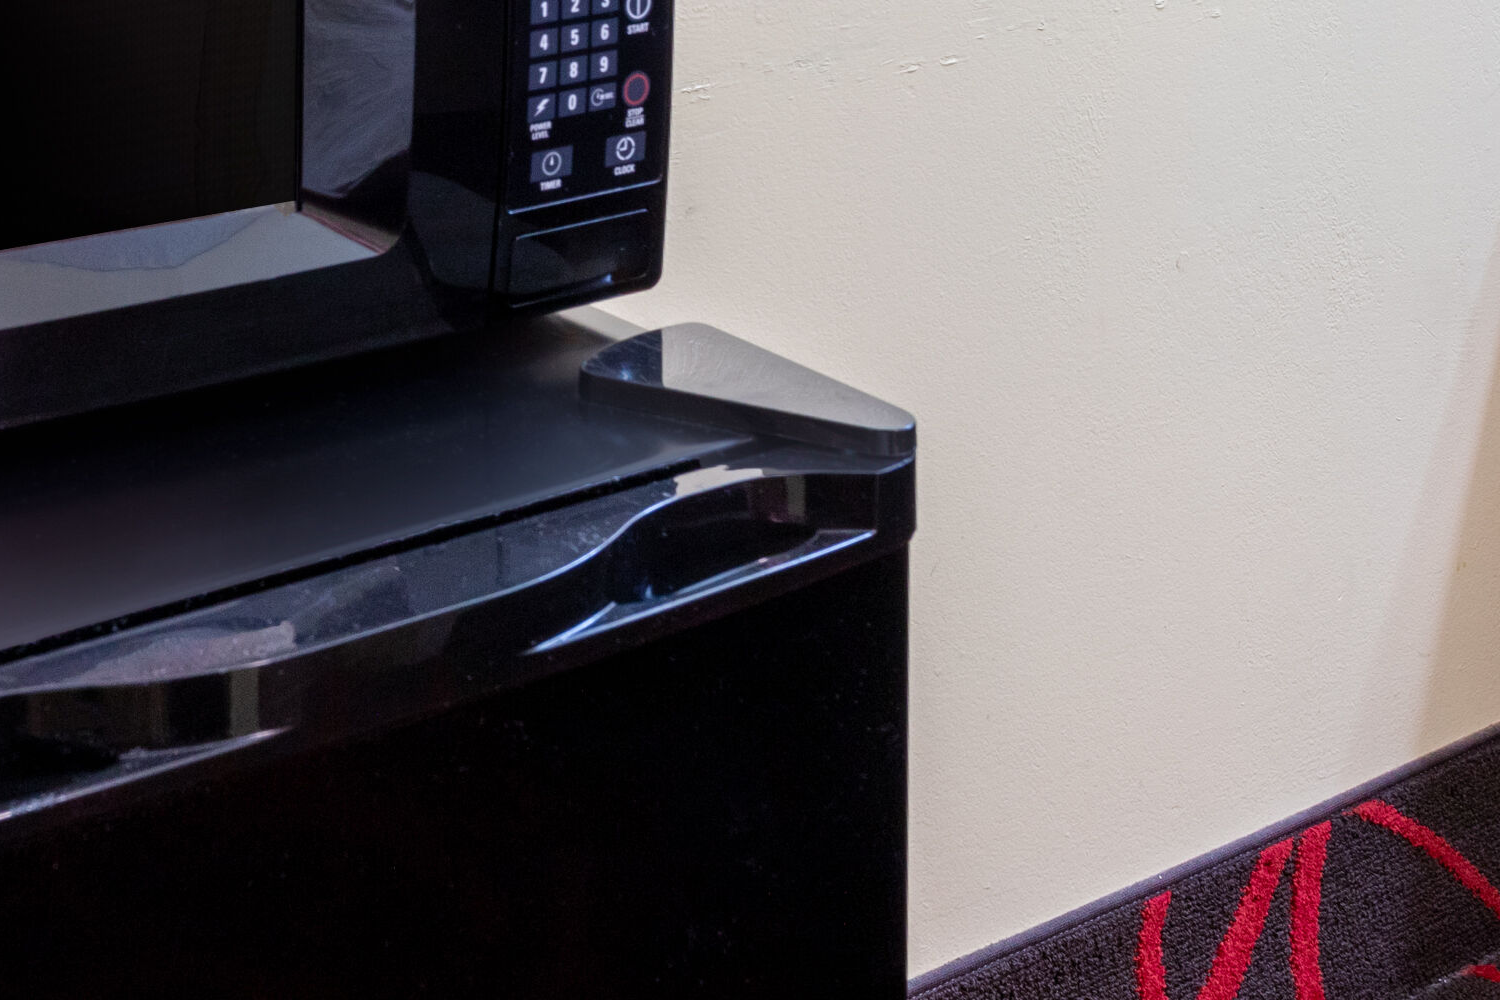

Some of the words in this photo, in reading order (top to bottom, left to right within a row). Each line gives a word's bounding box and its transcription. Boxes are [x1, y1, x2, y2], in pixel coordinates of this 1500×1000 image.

[541, 1, 548, 18] 1
[600, 24, 609, 40] 6
[627, 22, 649, 35] START
[539, 34, 548, 50] 4
[570, 29, 579, 45] 5
[569, 62, 578, 78] 8
[599, 56, 608, 73] 9
[539, 68, 547, 84] 7
[568, 94, 577, 110] 0
[627, 108, 644, 118] STOP
[530, 121, 552, 132] POWER
[625, 117, 644, 128] CLEAR
[531, 131, 550, 141] LEVEL
[614, 164, 635, 175] CLOCK
[541, 179, 562, 191] TIMER
